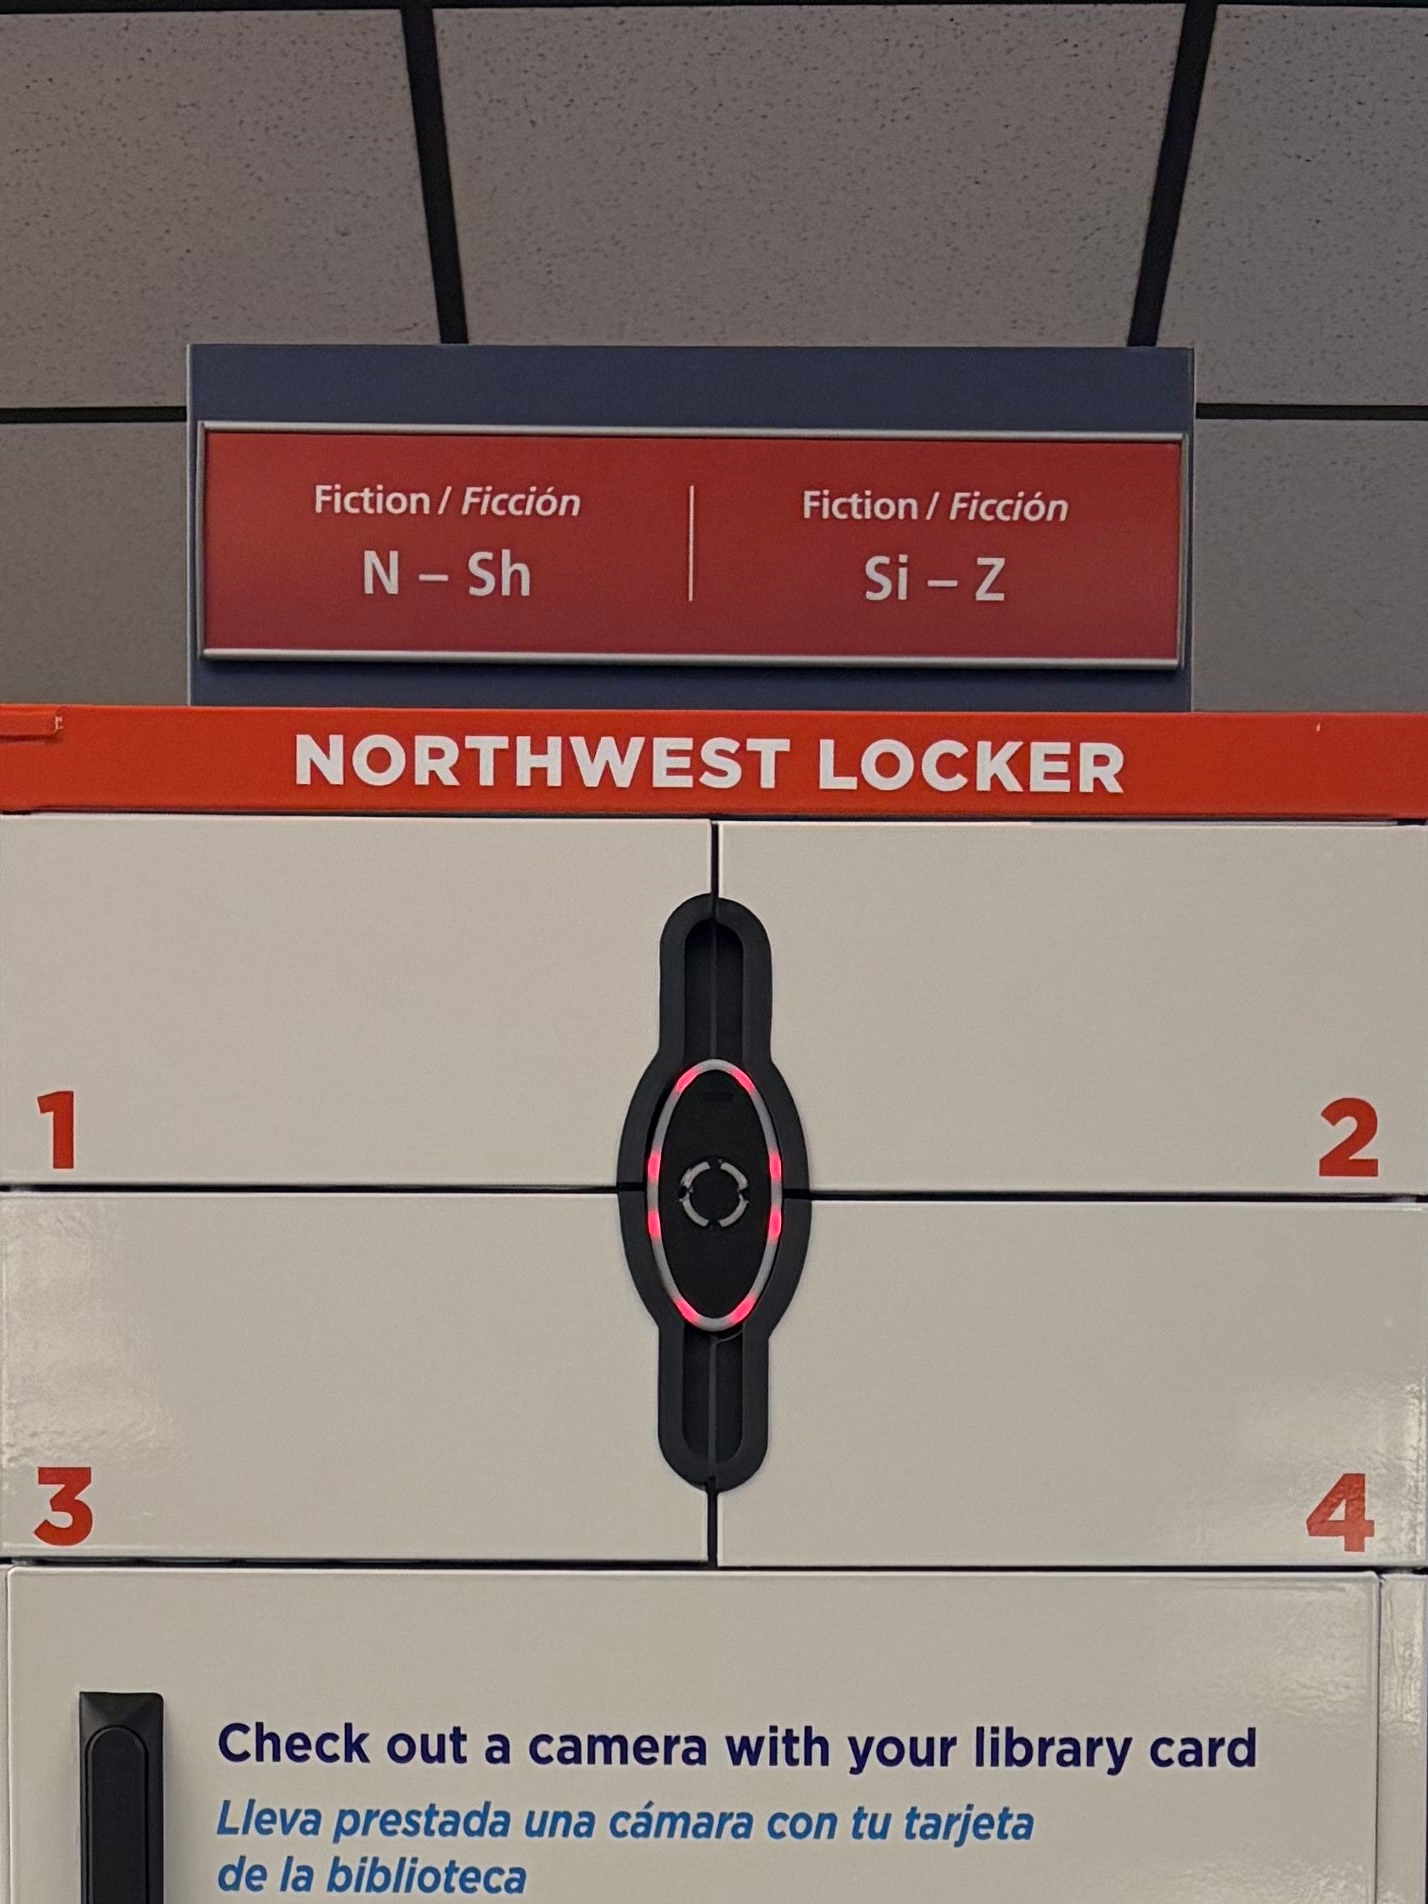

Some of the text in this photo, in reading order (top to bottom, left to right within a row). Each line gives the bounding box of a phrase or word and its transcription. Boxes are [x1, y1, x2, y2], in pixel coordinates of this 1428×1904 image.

[315, 483, 430, 515] Fiction
[461, 485, 581, 517] Ficción
[803, 489, 918, 520] Fiction
[949, 490, 1069, 522] Ficción
[363, 550, 399, 595] N
[468, 548, 530, 597] Sh
[865, 553, 909, 601] Si
[975, 557, 1006, 601] Z
[296, 734, 1124, 793] NORTHWEST LOCKER
[38, 1091, 73, 1169] 1
[1319, 1099, 1377, 1177] 2
[35, 1468, 92, 1546] 3
[1307, 1475, 1371, 1549] 4
[218, 1720, 1257, 1777] Check out a camera with your library card
[216, 1798, 1035, 1849] Lleva prestada una cámara con tu tarjeta
[217, 1854, 527, 1895] de la biblioteca
